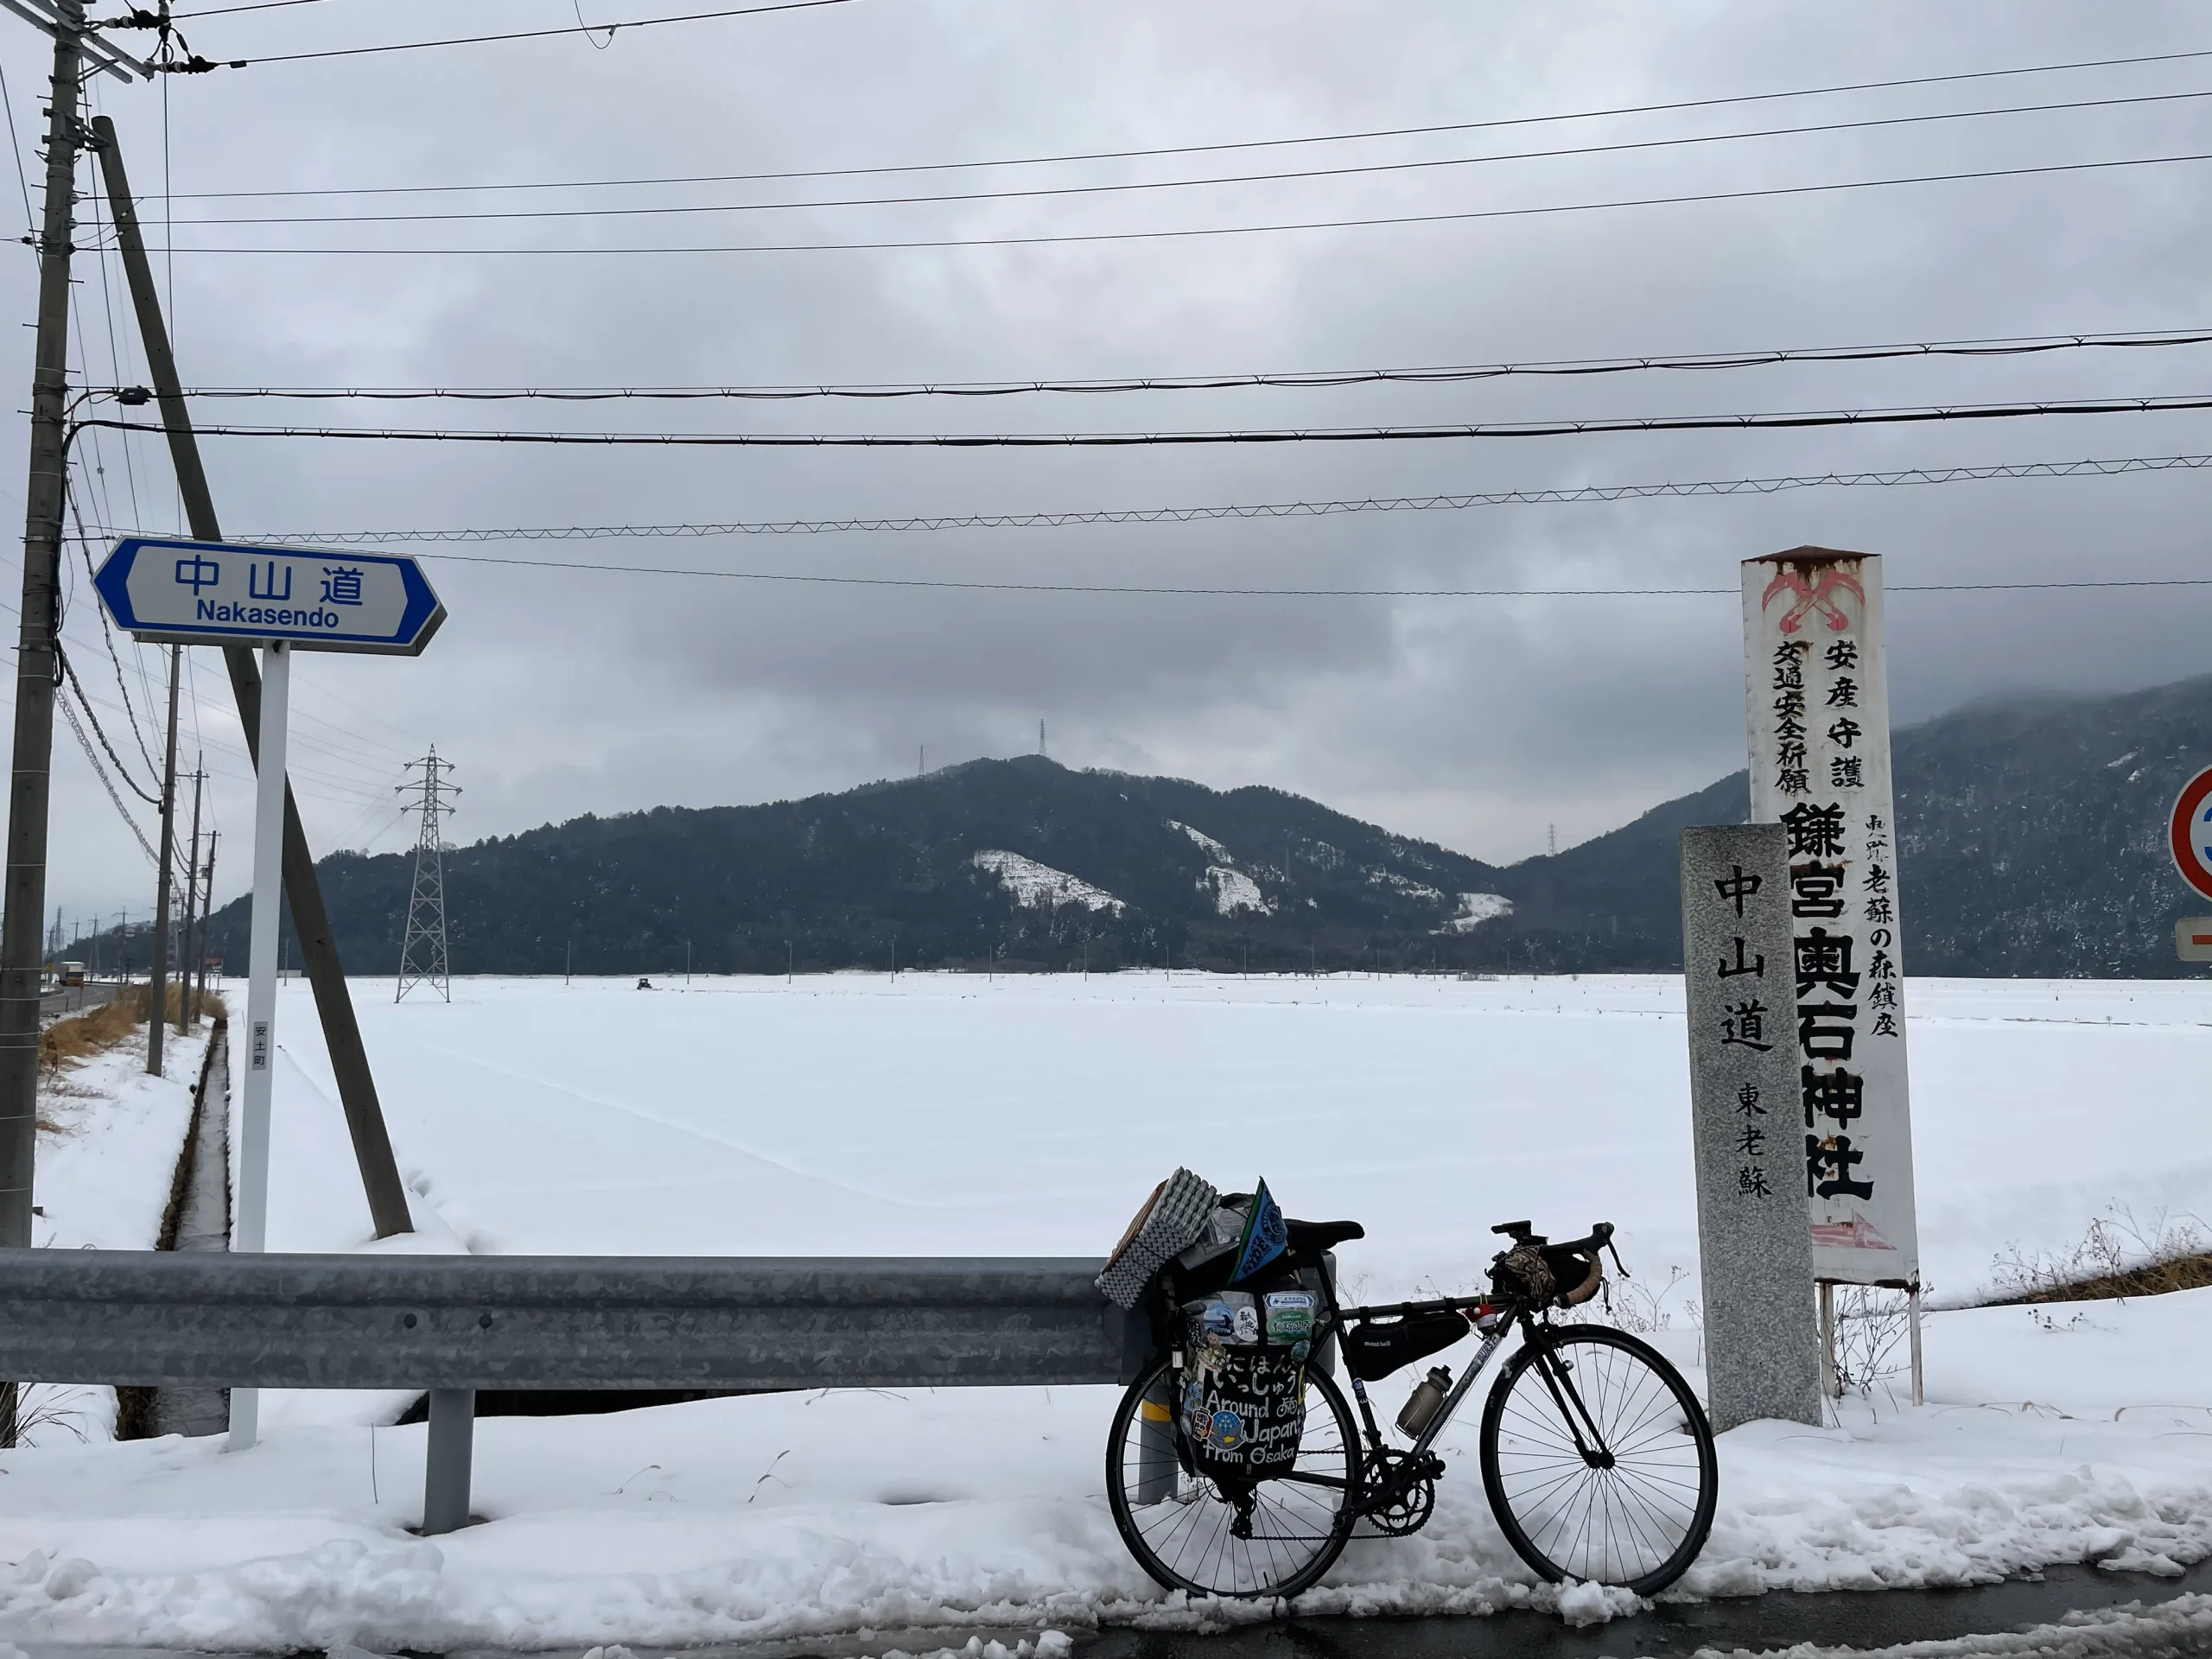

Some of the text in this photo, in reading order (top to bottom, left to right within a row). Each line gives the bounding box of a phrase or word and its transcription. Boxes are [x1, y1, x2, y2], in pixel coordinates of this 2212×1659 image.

[175, 554, 364, 607] 中山道
[196, 599, 340, 628] Nakasendo
[1772, 641, 1812, 794] 交通安全祈願
[1824, 639, 1865, 788] 安産守護
[254, 1027, 266, 1065] 安土町
[1714, 865, 1774, 1198] 中山道 東老蘇
[1226, 1353, 1293, 1375] にほん
[1212, 1370, 1297, 1395] いっしゅう
[1205, 1389, 1269, 1419] Around
[1243, 1418, 1298, 1449] Japan
[1202, 1438, 1295, 1465] from Osaka
